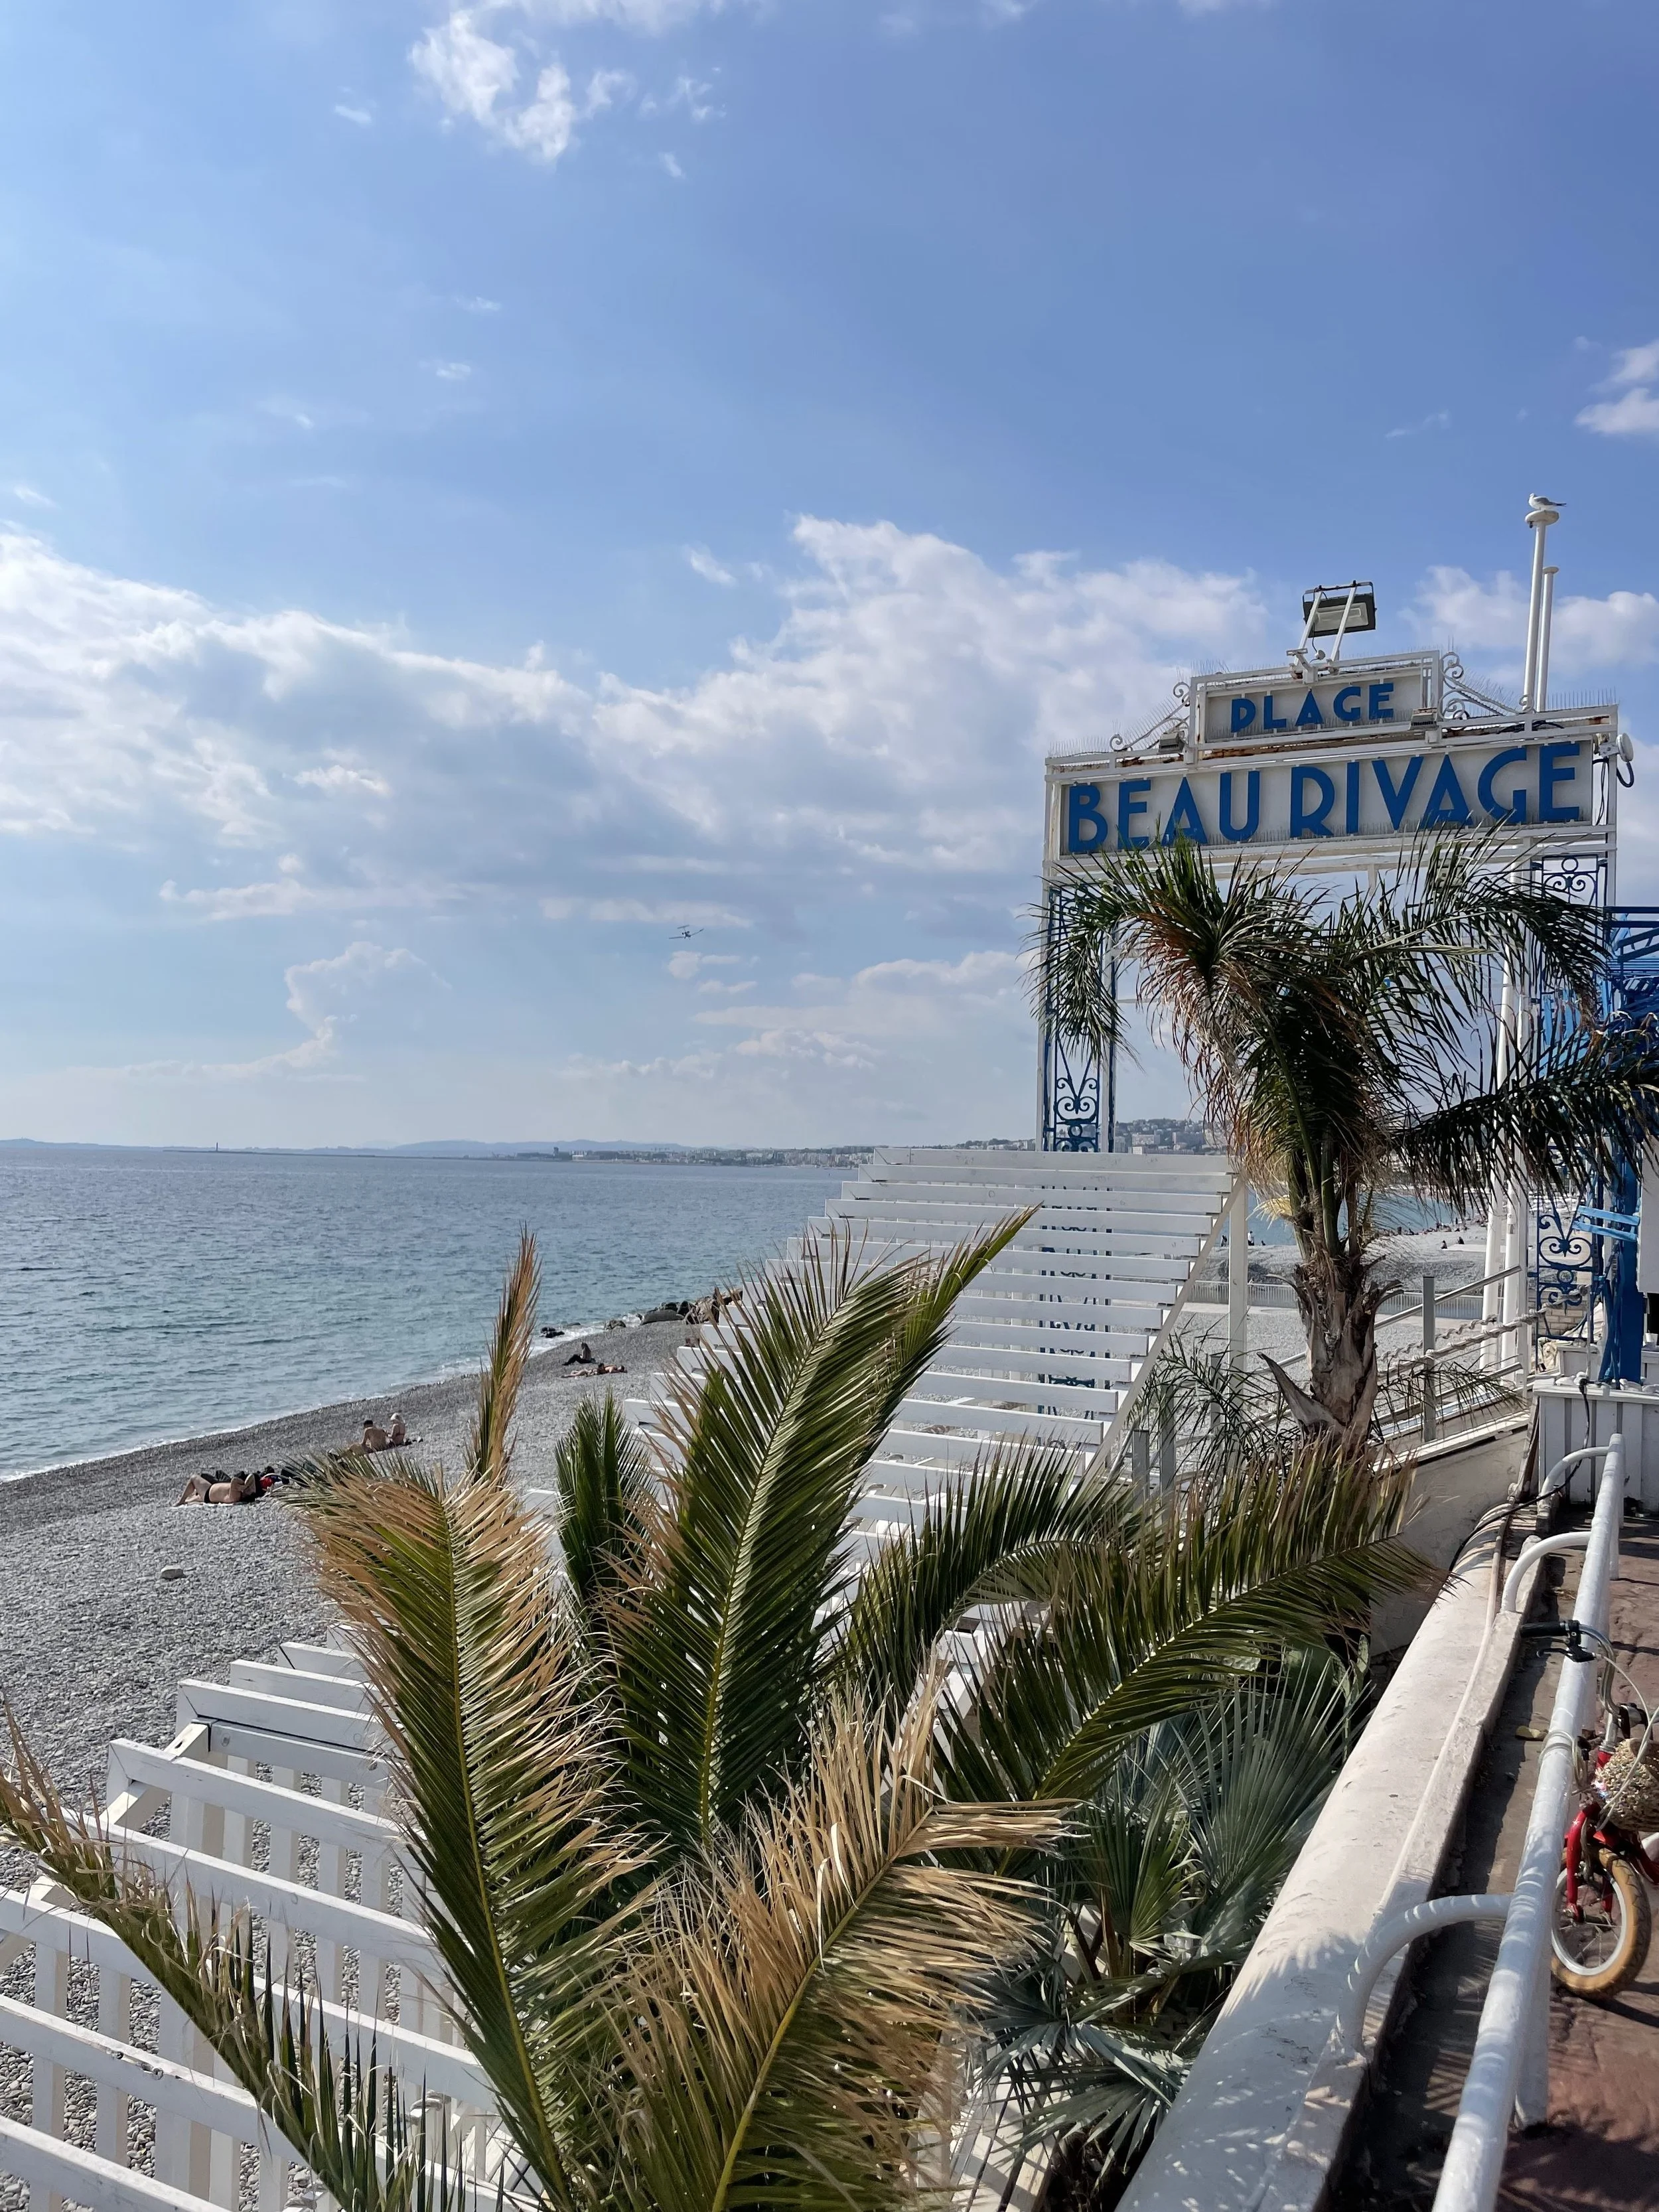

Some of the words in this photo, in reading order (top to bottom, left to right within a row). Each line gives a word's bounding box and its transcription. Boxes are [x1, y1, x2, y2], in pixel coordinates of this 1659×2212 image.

[1231, 683, 1394, 733] PLAGE
[1067, 771, 1260, 853] BEAU
[1289, 741, 1581, 838] RIVAGE
